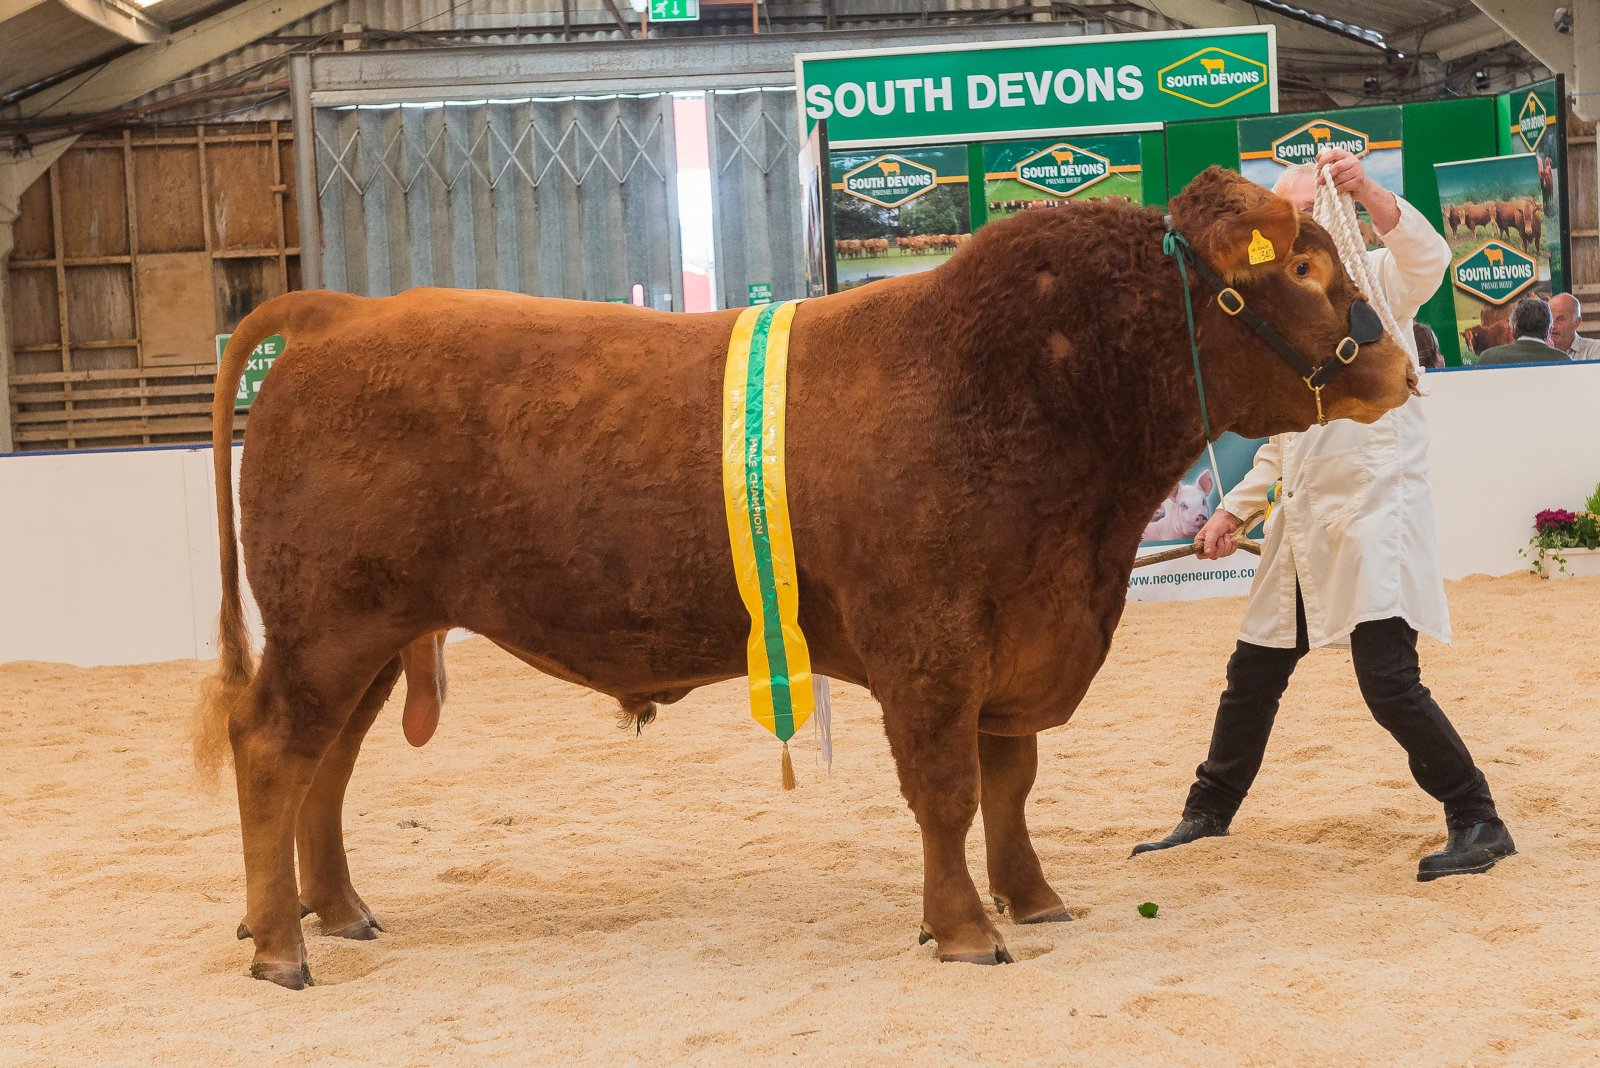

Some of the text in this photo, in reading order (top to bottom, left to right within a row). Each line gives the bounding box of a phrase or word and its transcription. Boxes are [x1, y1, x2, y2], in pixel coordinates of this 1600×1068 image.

[1166, 71, 1260, 88] SOUTH DEVONS
[806, 65, 1144, 119] SOUTH DEVONS
[1278, 143, 1315, 158] SOUTH
[1022, 163, 1105, 179] SOUTH DEVONS
[849, 174, 931, 190] SOUTH DEVONS
[1459, 263, 1532, 282] SOUTH DEVONS
[252, 343, 276, 355] RE
[245, 358, 276, 370] XIT
[748, 438, 763, 535] MALE CHAMPION
[1130, 568, 1257, 586] ww.neogeneurope.co
